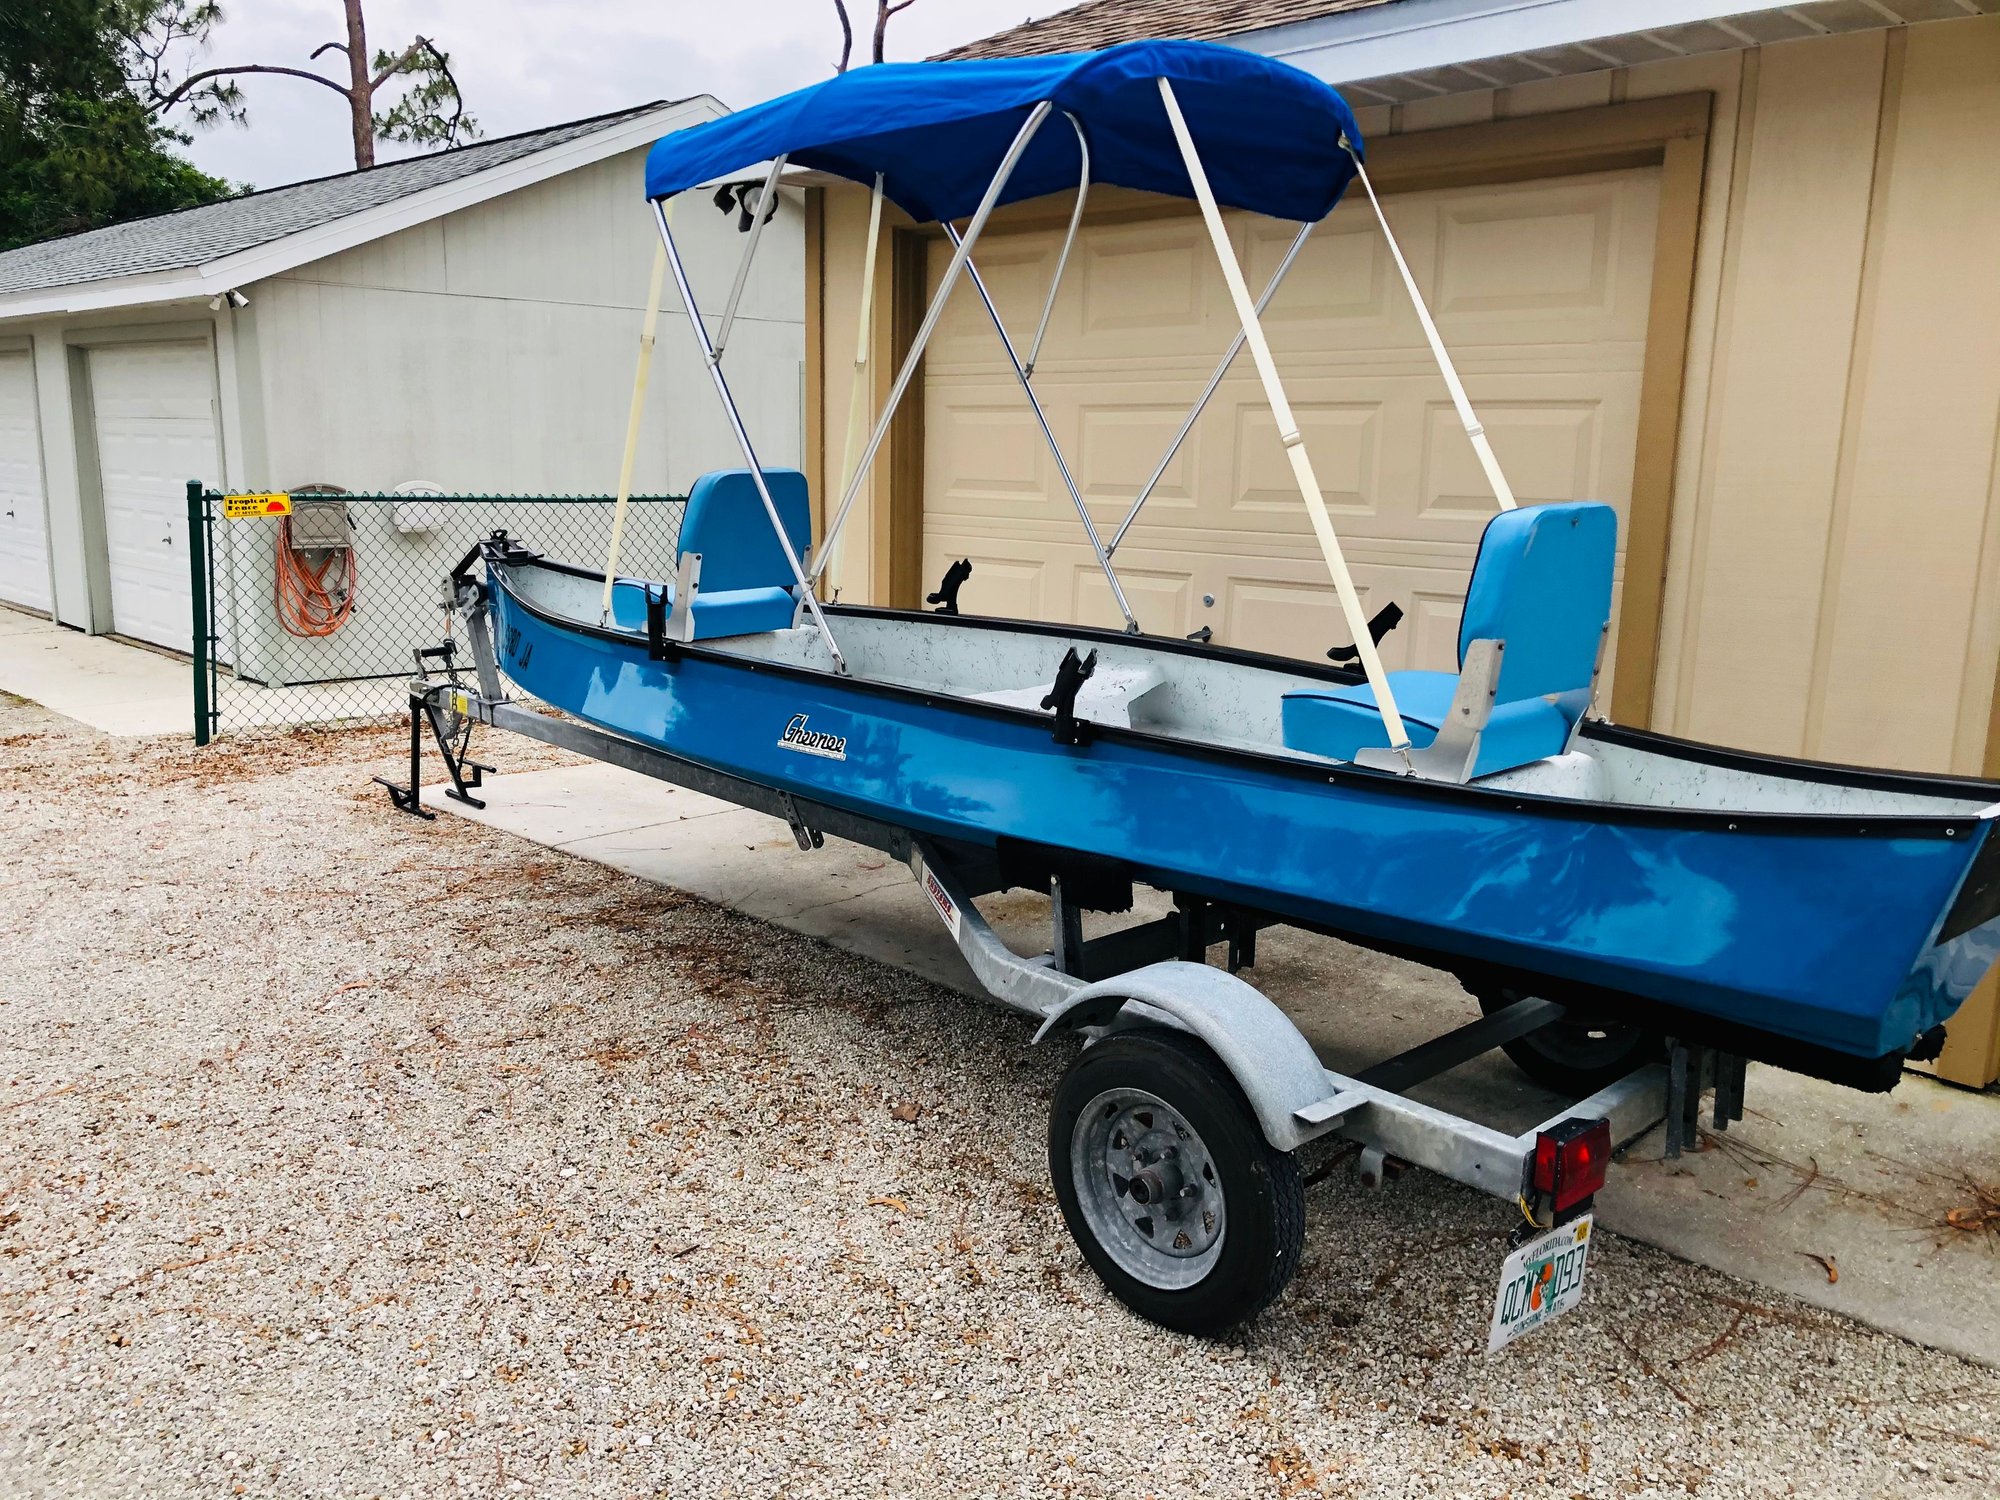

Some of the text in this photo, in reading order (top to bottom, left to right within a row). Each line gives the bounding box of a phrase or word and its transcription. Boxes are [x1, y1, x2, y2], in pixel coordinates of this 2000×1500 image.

[783, 713, 846, 753] Gheenoe
[1552, 1244, 1585, 1300] D93
[1512, 1309, 1543, 1334] SUNSHINE
